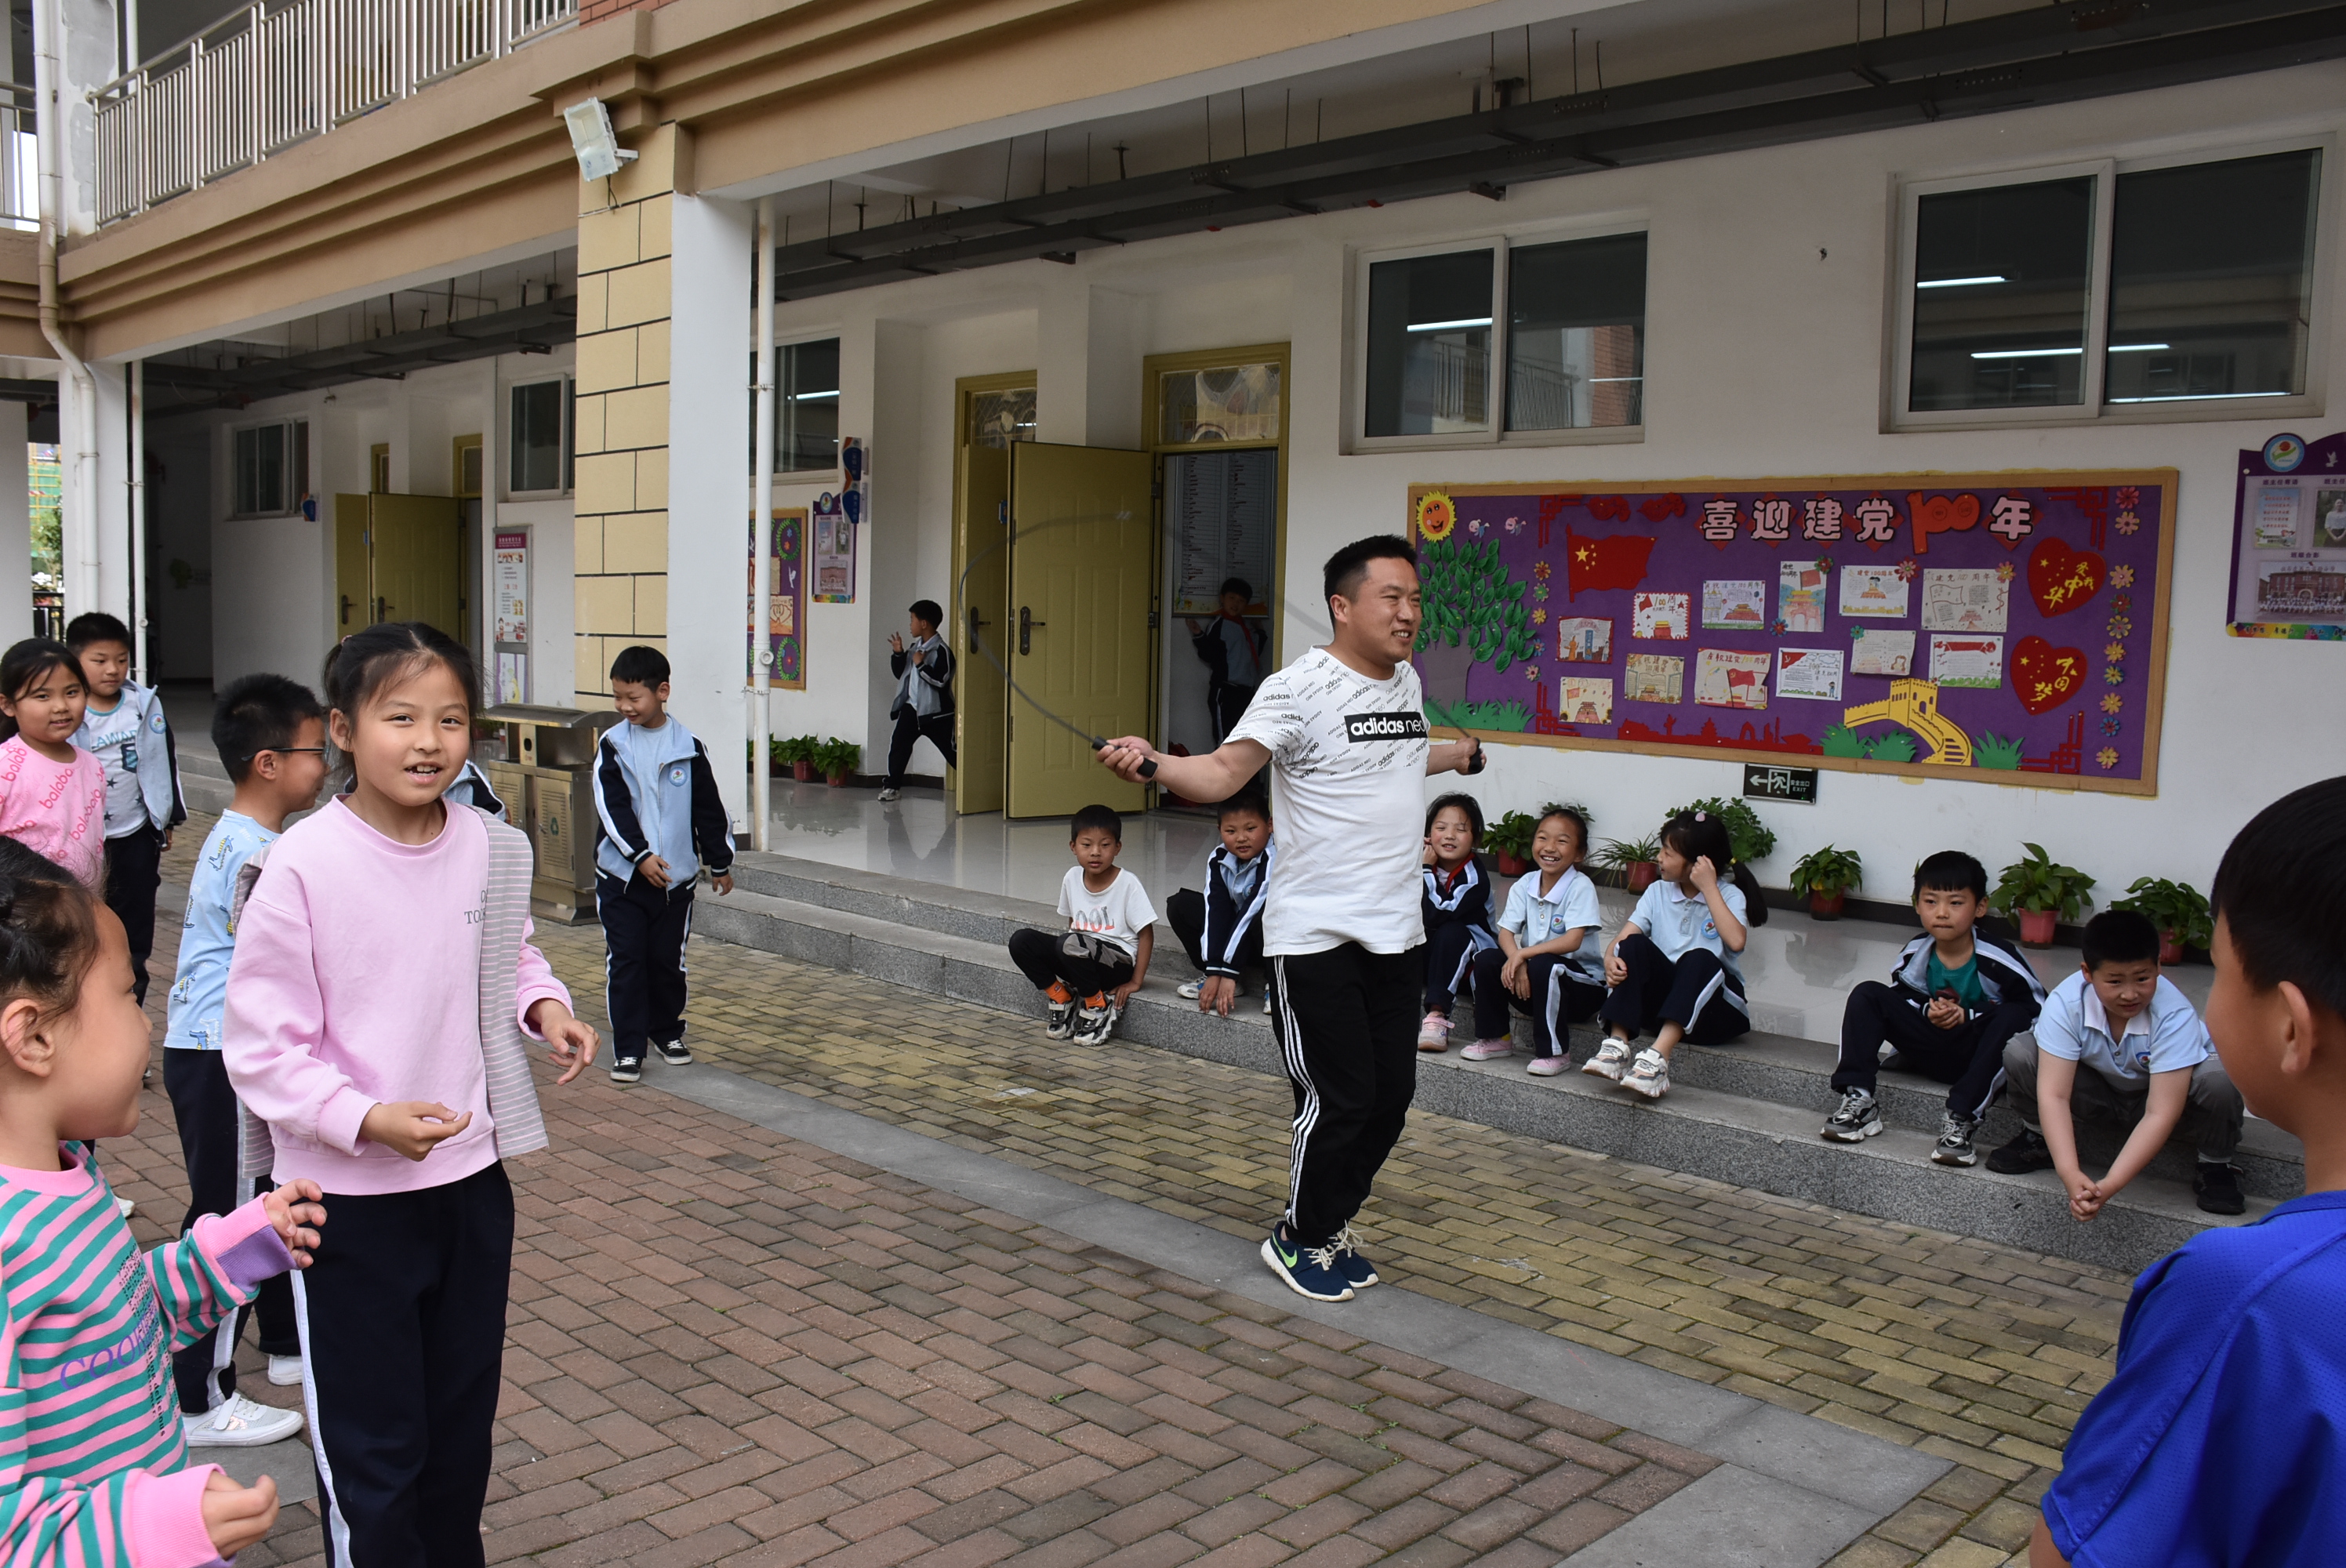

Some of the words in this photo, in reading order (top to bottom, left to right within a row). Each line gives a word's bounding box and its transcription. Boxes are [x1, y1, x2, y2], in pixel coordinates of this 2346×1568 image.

[1263, 693, 1291, 702] adidas
[1310, 710, 1323, 721] ADIDAS
[1327, 724, 1342, 735] ADIDAS
[1350, 715, 1404, 735] adidas
[1405, 719, 1425, 734] neo
[1378, 751, 1395, 767] adidas
[1395, 743, 1404, 753] neo
[1350, 762, 1364, 772] ADIDAS
[1071, 906, 1115, 933] OOL
